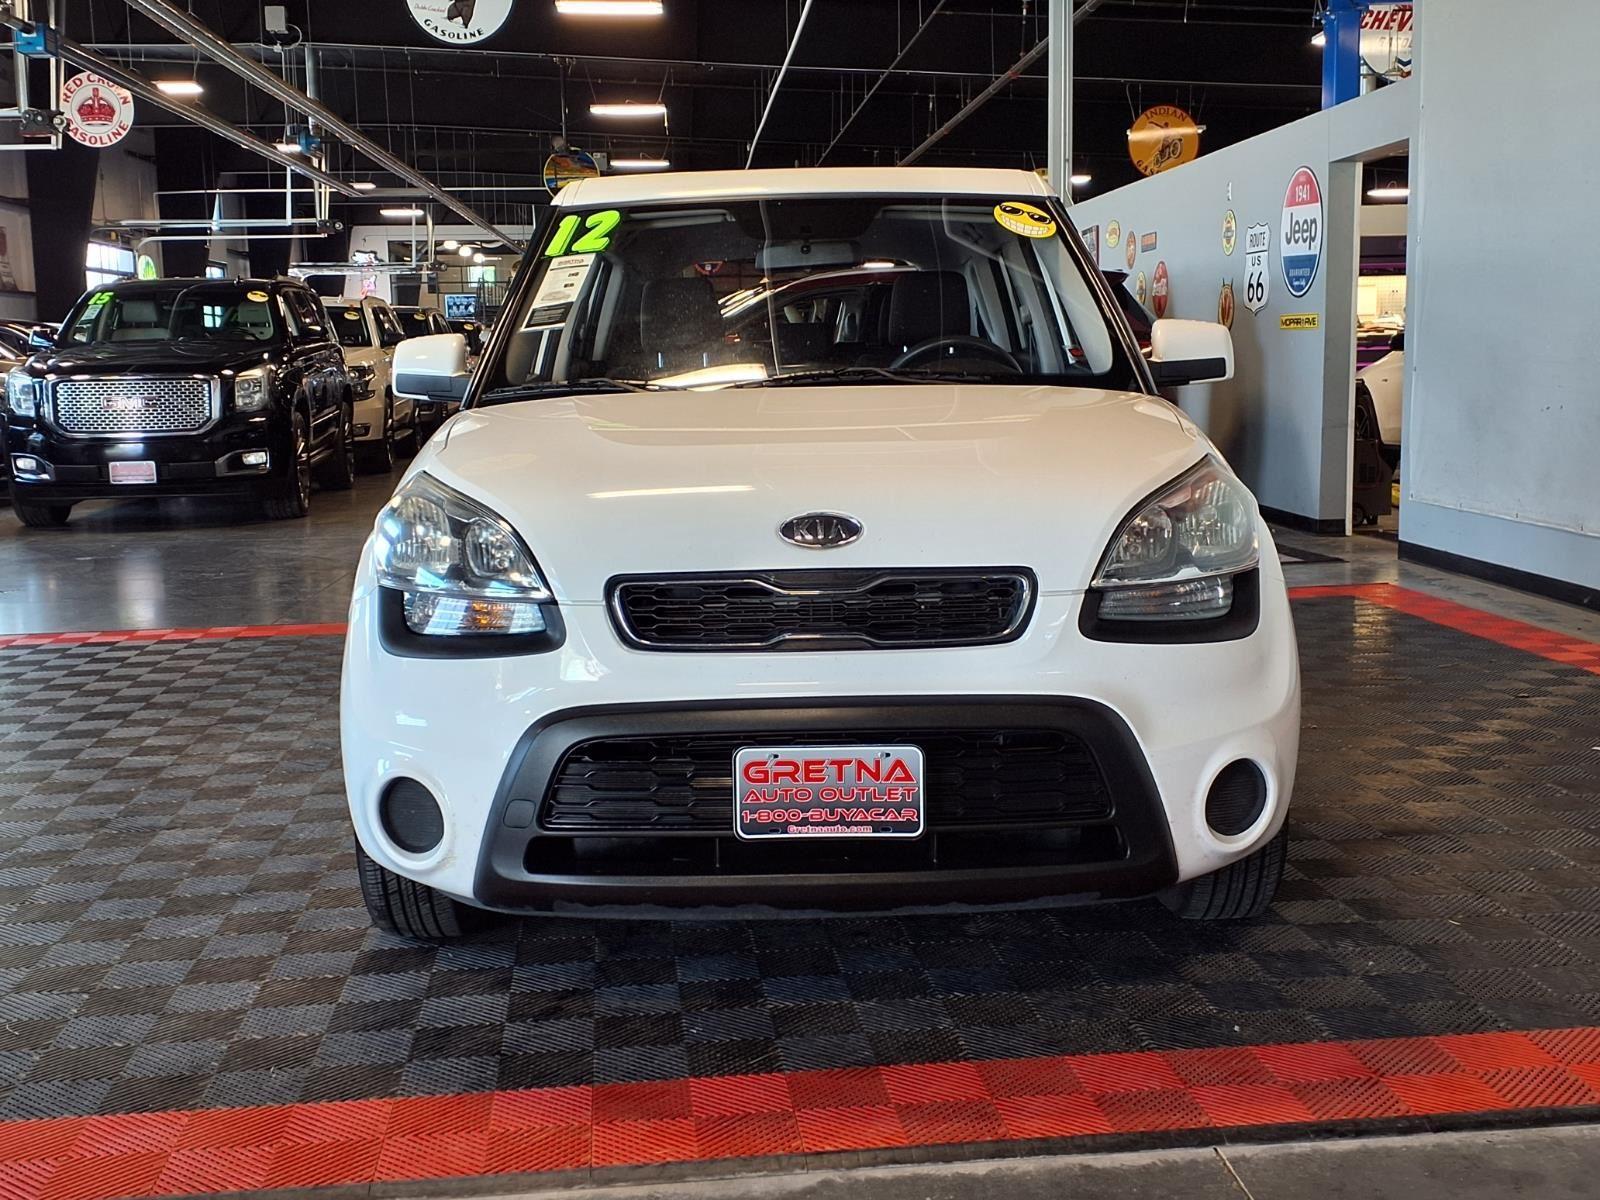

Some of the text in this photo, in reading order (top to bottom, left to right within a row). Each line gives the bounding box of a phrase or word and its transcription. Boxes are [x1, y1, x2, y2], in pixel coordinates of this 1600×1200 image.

[424, 18, 485, 40] GASOLINE
[1360, 9, 1413, 32] CHEV
[63, 77, 84, 104] RED
[1144, 107, 1188, 122] INDIAN
[1295, 184, 1311, 203] 1941
[544, 210, 621, 258] 12
[1249, 231, 1266, 248] ROUTE
[1285, 212, 1318, 250] Jeep
[1251, 255, 1262, 267] US
[1247, 271, 1264, 303] 66
[87, 292, 114, 306] 15
[1281, 317, 1302, 327] MOPAR
[102, 396, 160, 409] GMC
[793, 518, 847, 540] KIA
[742, 757, 917, 785] GRETNA
[742, 787, 918, 804] AUTO OUTLET
[742, 808, 919, 824] 1-800-BUYACAR
[787, 825, 873, 834] Gretnaauto.com
